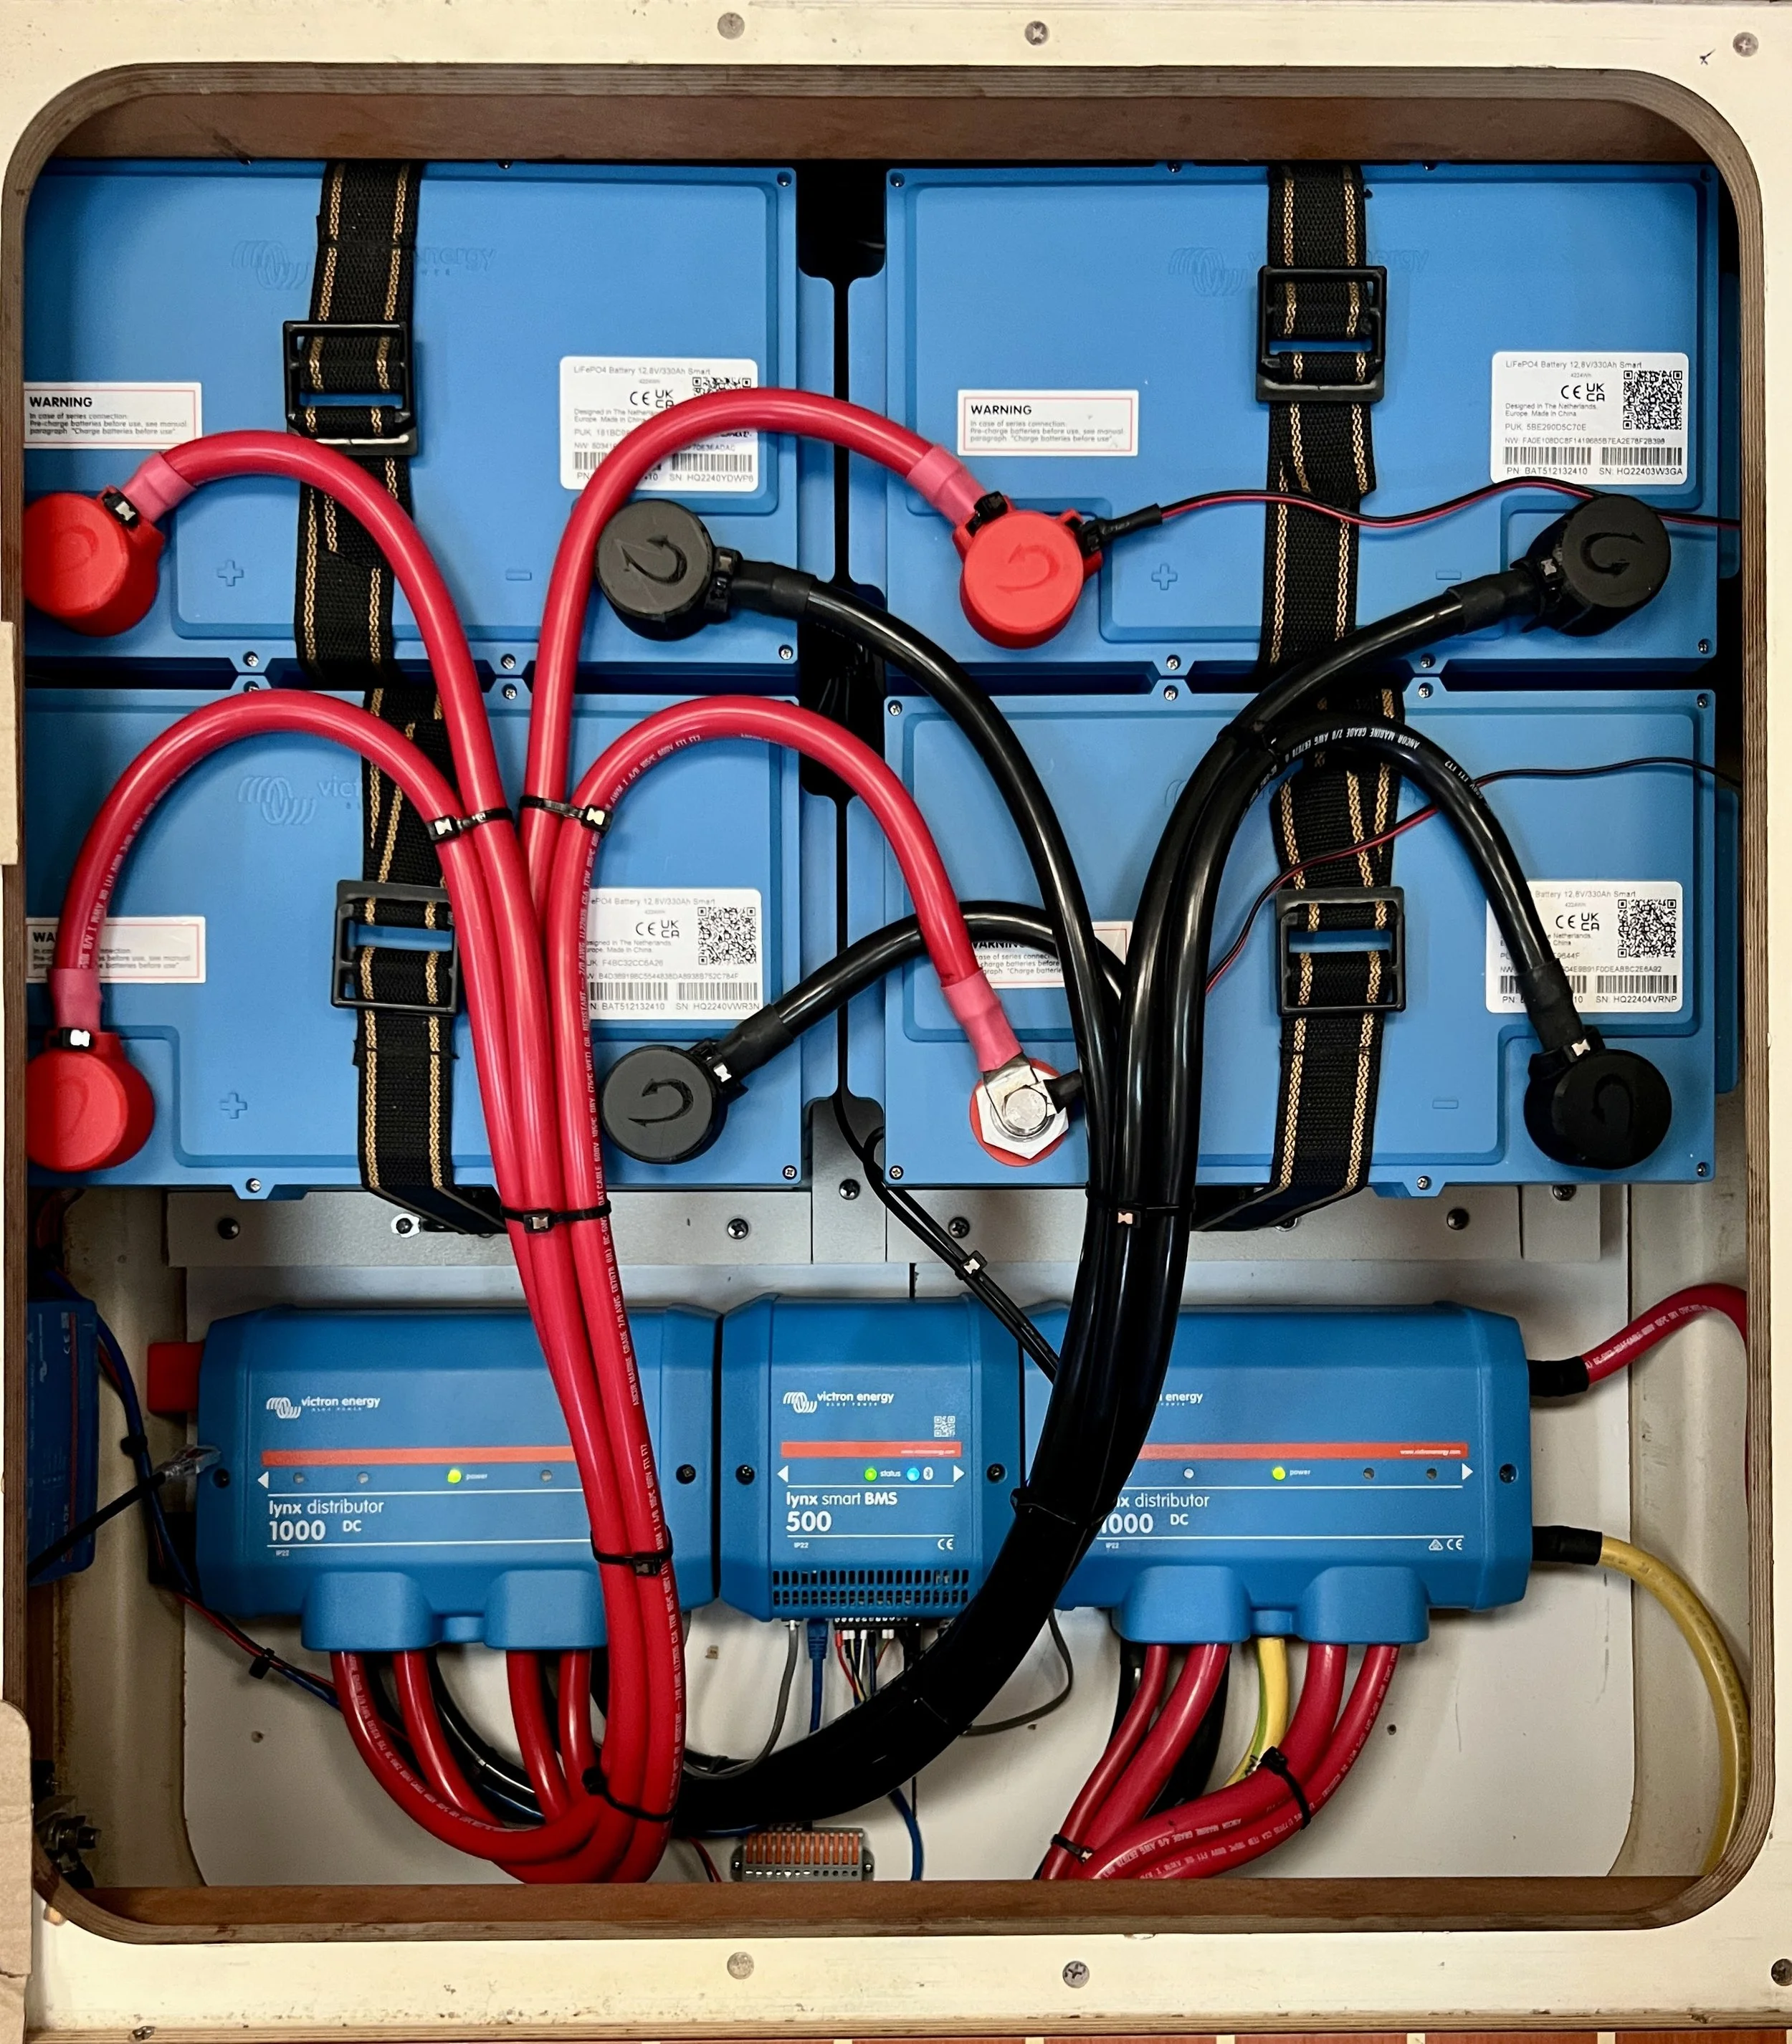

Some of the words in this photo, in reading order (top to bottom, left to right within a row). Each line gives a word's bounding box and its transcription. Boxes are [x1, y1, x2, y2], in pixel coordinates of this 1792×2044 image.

[1540, 360, 1567, 370] Battery
[655, 389, 674, 399] UK
[1560, 384, 1581, 400] CE
[1586, 383, 1605, 393] UK
[29, 396, 93, 408] WARNING
[629, 391, 650, 406] CE
[1586, 393, 1605, 402] CA
[971, 405, 1032, 415] WARNING
[1314, 732, 1329, 745] AWG
[1346, 727, 1367, 738] GRADE
[1370, 727, 1395, 742] MARINE
[1398, 734, 1420, 750] ANCOR
[318, 775, 359, 798] vict
[1535, 891, 1561, 899] Battery
[615, 898, 640, 907] Battery
[1555, 914, 1576, 929] CE
[1581, 912, 1599, 922] UK
[635, 922, 656, 936] CE
[661, 920, 679, 929] UK
[1581, 922, 1600, 932] CA
[661, 930, 680, 938] CA
[301, 1396, 339, 1407] victron
[341, 1397, 381, 1408] energy
[816, 1391, 854, 1402] victron
[856, 1393, 895, 1404] energy
[1165, 1393, 1204, 1404] energy
[465, 1471, 488, 1481] power
[880, 1469, 901, 1478] status
[1290, 1468, 1311, 1477] power
[786, 1491, 818, 1509] lynx
[821, 1491, 862, 1506] smart
[864, 1491, 898, 1506] BMS
[1135, 1493, 1210, 1507] distributor
[268, 1500, 302, 1518] lynx
[307, 1499, 385, 1515] distributor
[786, 1511, 832, 1532] 500
[1170, 1514, 1188, 1526] DC
[268, 1519, 326, 1542] 1000
[342, 1520, 362, 1532] DC
[937, 1538, 954, 1550] CE
[1447, 1538, 1464, 1550] CE
